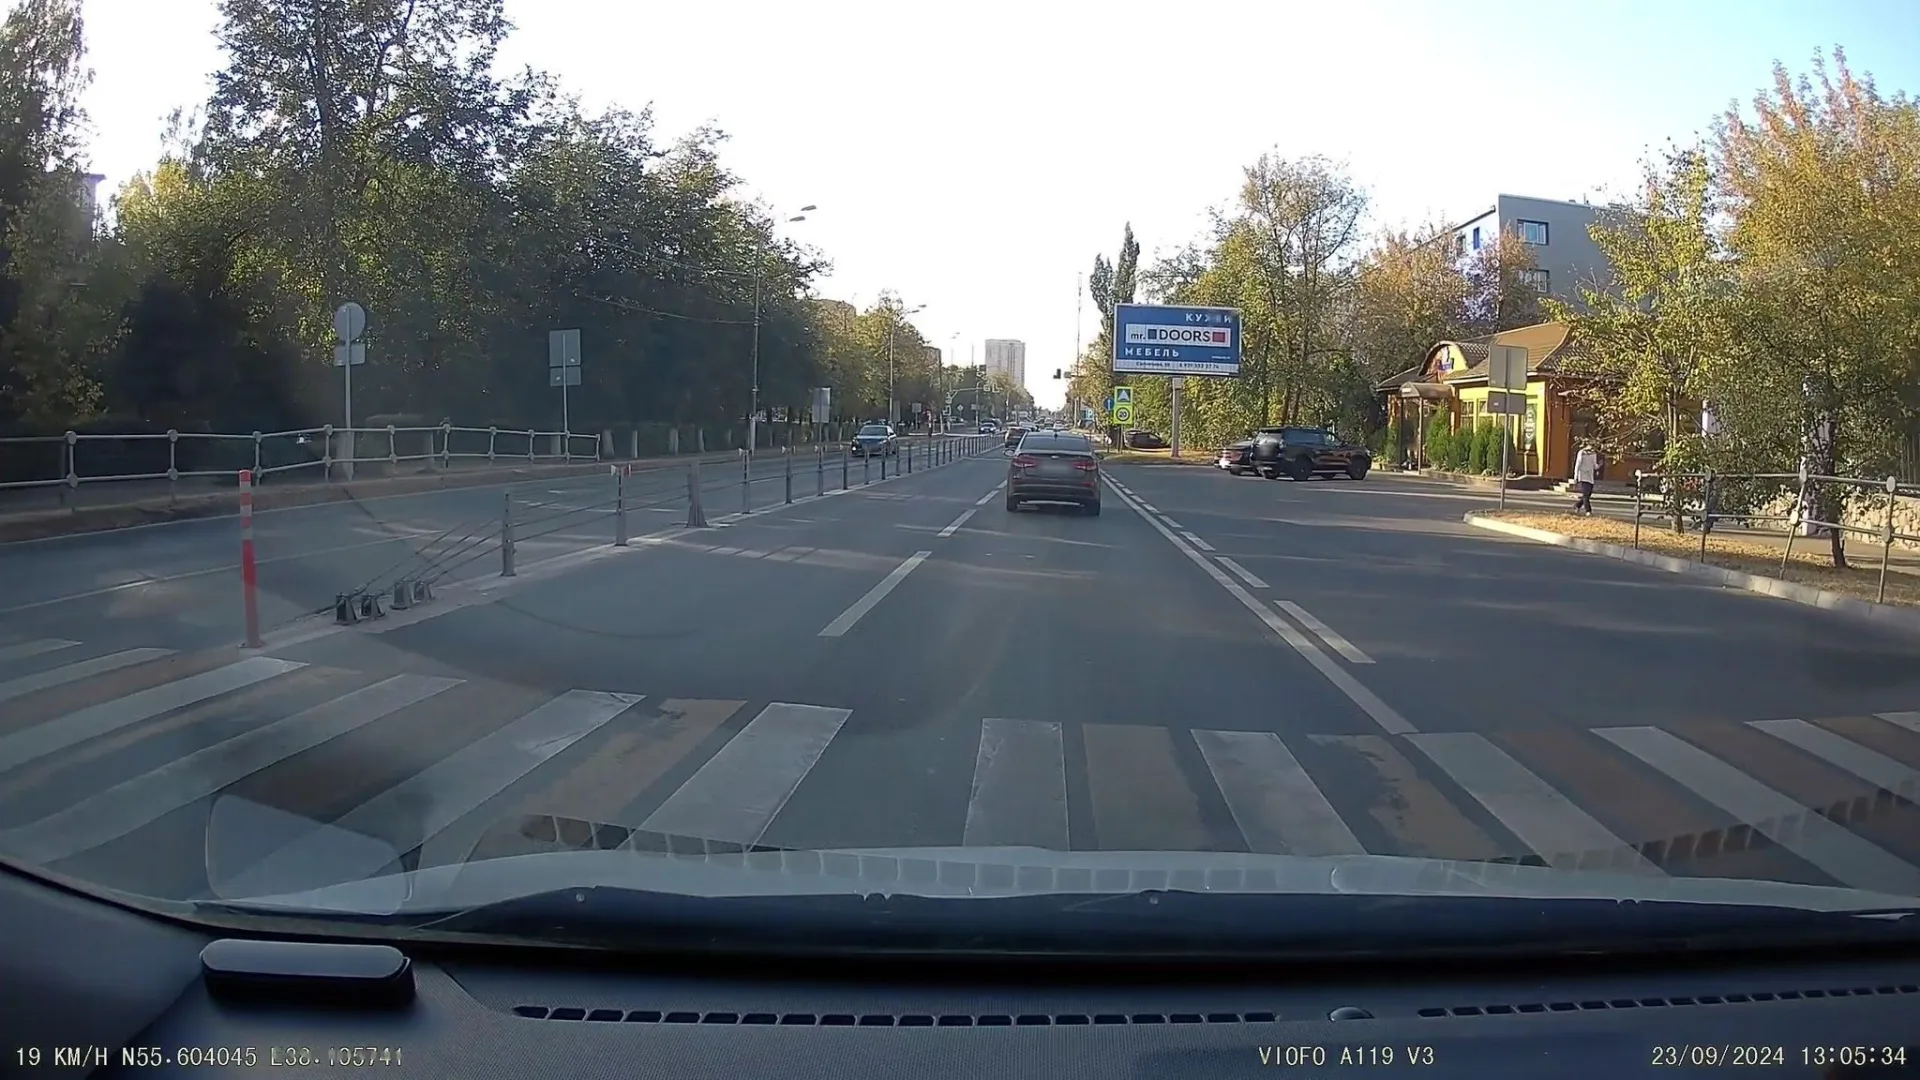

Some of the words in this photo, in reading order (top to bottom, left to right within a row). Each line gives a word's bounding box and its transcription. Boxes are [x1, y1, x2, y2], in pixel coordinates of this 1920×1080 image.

[1130, 332, 1146, 340] mr.
[1159, 329, 1211, 342] DOORS
[1124, 347, 1180, 357] МЕБЕЛЬ
